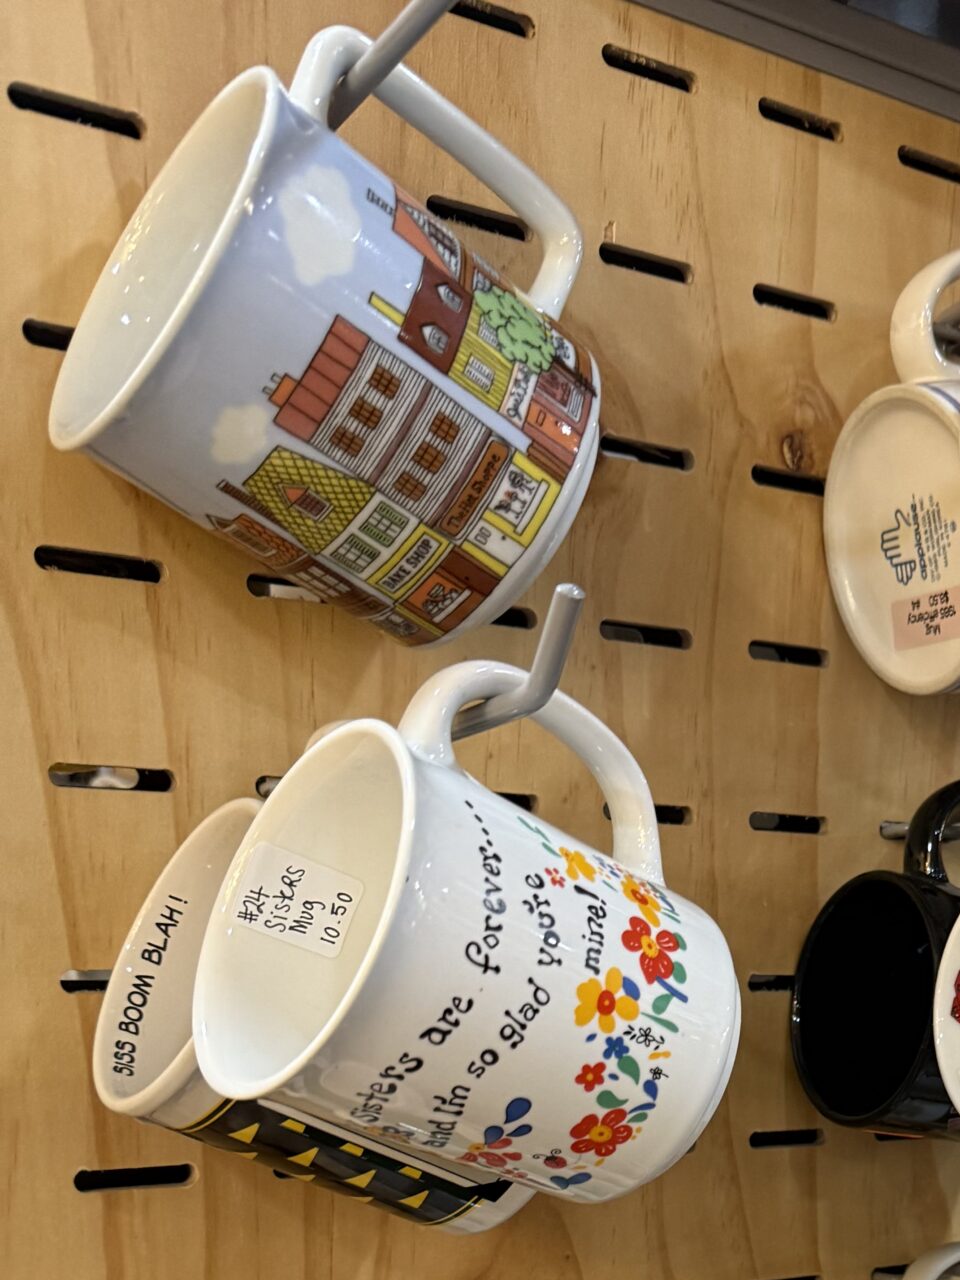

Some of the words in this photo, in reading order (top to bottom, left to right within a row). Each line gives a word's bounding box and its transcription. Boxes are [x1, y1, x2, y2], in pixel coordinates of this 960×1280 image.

[382, 563, 412, 589] BAKE
[406, 538, 433, 568] SHOP
[911, 503, 927, 580] applause
[141, 895, 188, 965] BLAH!
[237, 885, 270, 924] #24
[289, 900, 326, 934] Mug
[320, 892, 353, 944] 10.50
[522, 873, 562, 968] you're
[574, 885, 608, 975] mine!
[119, 975, 155, 1035] BOOM
[500, 977, 551, 1049] glad
[113, 1039, 136, 1077] SISS
[351, 1052, 424, 1122] Sisters
[419, 996, 473, 1046] are
[467, 1049, 499, 1078] so
[434, 1085, 471, 1117] I'm
[422, 1119, 456, 1149] and
